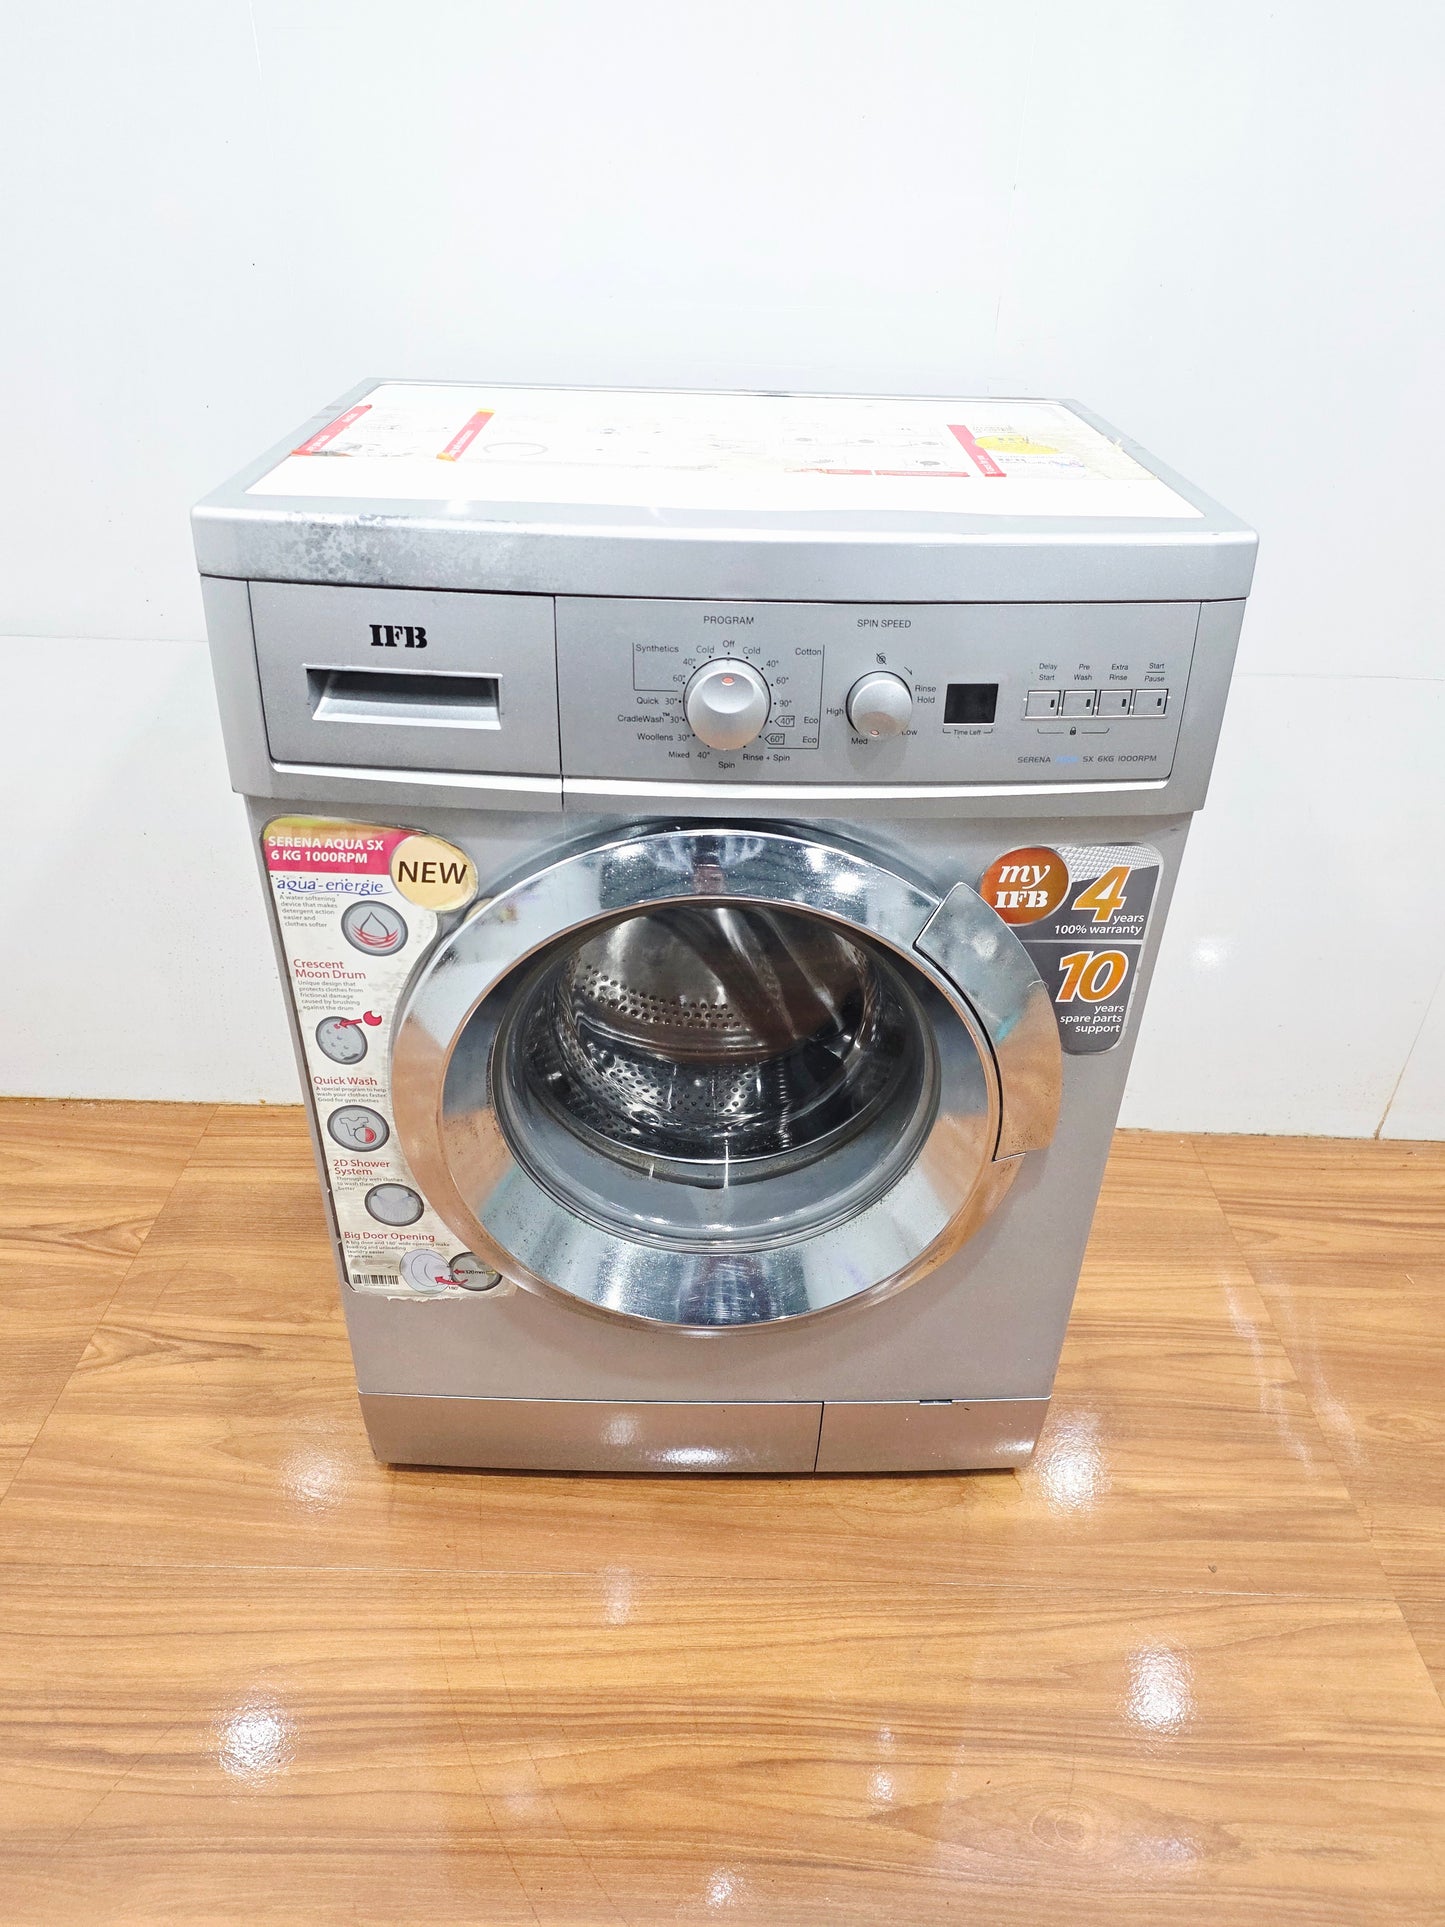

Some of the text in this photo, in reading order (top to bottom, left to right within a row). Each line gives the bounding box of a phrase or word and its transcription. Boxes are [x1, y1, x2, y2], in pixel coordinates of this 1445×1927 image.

[703, 615, 755, 625] PROGRAM
[857, 619, 912, 628] SPIN SPEED
[369, 624, 428, 648] IFB
[722, 640, 735, 648] Off
[635, 644, 679, 654] Synthetics
[696, 645, 715, 654] Cold
[742, 646, 761, 655] Cold
[795, 648, 822, 656] Cotton
[683, 658, 696, 666] 40°
[766, 660, 779, 668] 40°
[1039, 663, 1058, 671] Delay
[776, 676, 789, 684] 60°
[1144, 675, 1165, 683] Pause
[636, 697, 678, 705] Quick 30°
[779, 699, 792, 707] 90°
[826, 707, 844, 716] High
[670, 715, 683, 723] 30°
[780, 716, 818, 725] 40° Eco
[637, 733, 690, 742] Woollens 30°
[770, 735, 817, 744] 60° Eco
[851, 737, 868, 745] Med
[668, 751, 710, 759] Mixed 40°
[742, 753, 764, 761] Rinse
[772, 754, 791, 762] Spin
[1082, 755, 1095, 763] SX
[1097, 755, 1115, 763] 6KG
[1118, 755, 1157, 763] 1000RPM
[718, 761, 735, 770] Spin
[268, 836, 384, 851] SERENA AQUA SX
[271, 850, 368, 864] 6 KG 1000RPM
[397, 860, 468, 885] NEW
[999, 865, 1051, 889] my
[1071, 865, 1132, 923] 4
[305, 895, 336, 903] softening
[994, 890, 1049, 909] IFB
[1112, 914, 1144, 925] years
[1054, 925, 1142, 936] 100% warranty
[293, 959, 344, 969] Crescent
[295, 969, 366, 979] Moon Drum
[1055, 949, 1130, 1003] 10
[1094, 1005, 1125, 1014] years
[1060, 1015, 1122, 1024] spare parts
[1075, 1025, 1120, 1034] support
[313, 1076, 378, 1086] Quick Wash
[333, 1159, 391, 1168] 2D Shower
[334, 1167, 373, 1176] System
[344, 1231, 435, 1243] Big Door Opening
